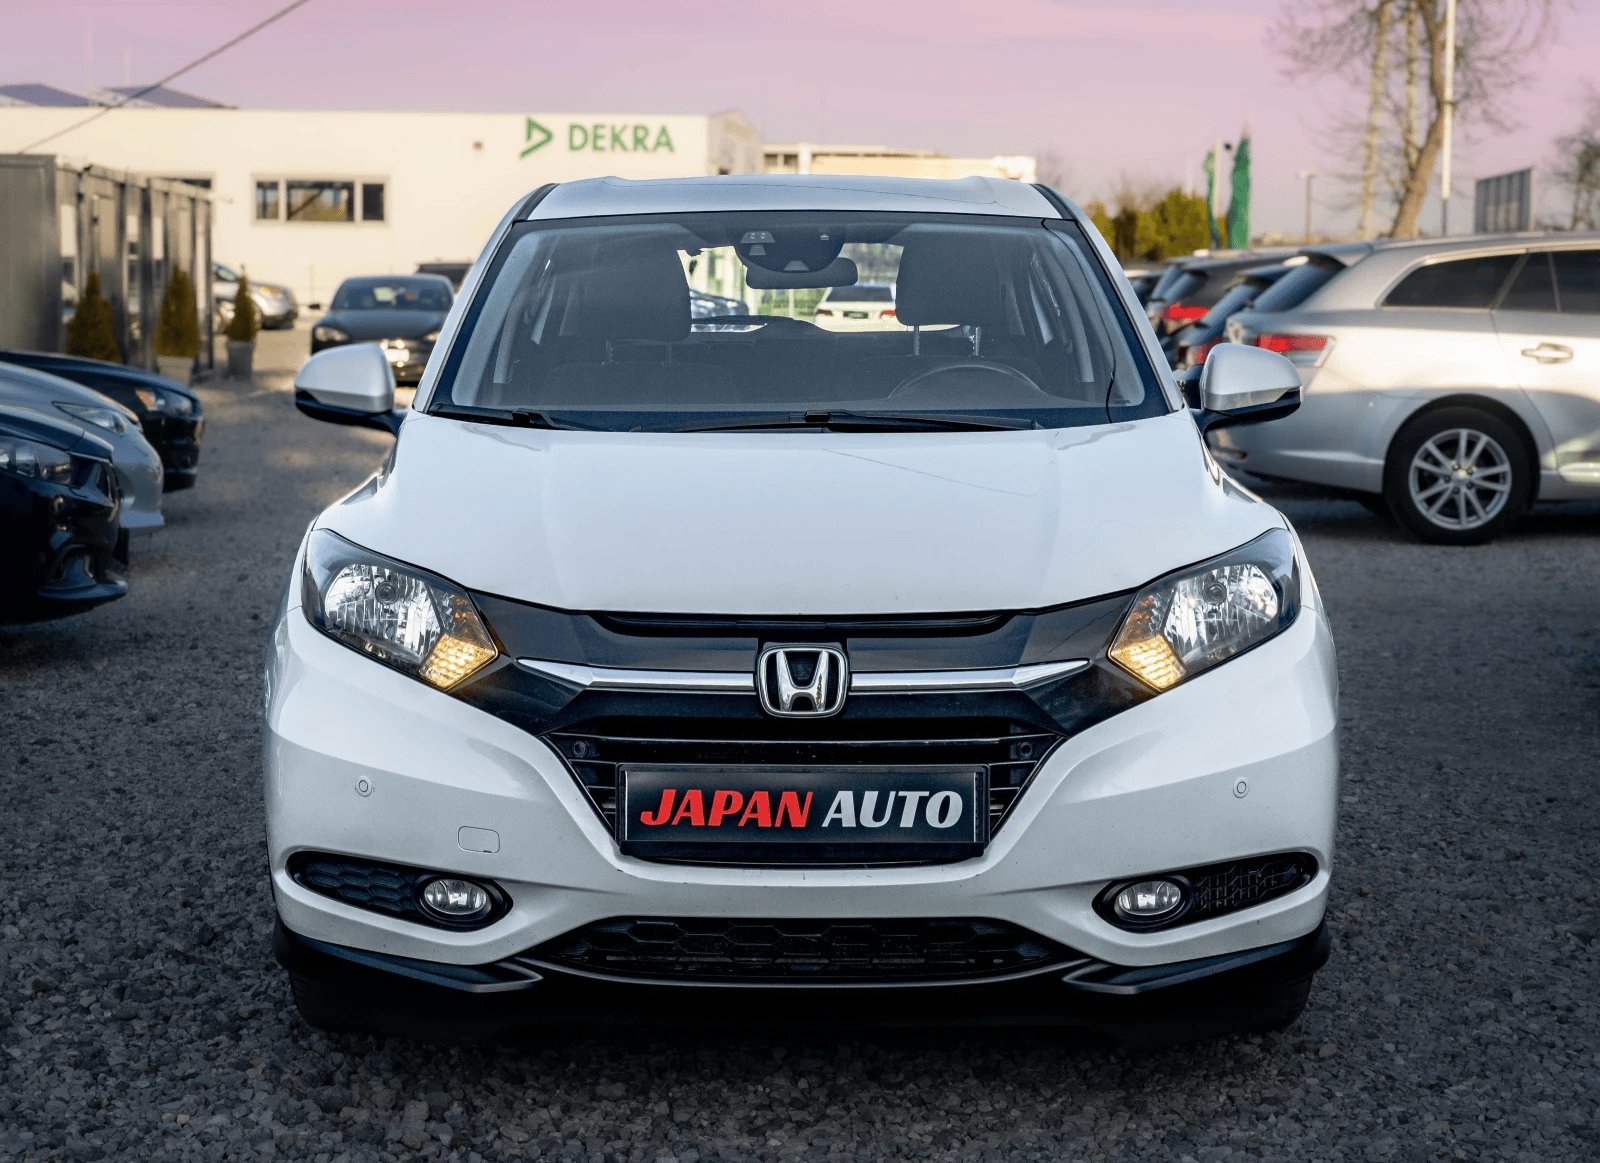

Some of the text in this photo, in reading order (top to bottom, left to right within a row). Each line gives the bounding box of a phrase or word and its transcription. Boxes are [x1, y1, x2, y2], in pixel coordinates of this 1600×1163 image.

[568, 124, 674, 152] DEKRA
[640, 789, 963, 829] JAPAN AUTO
